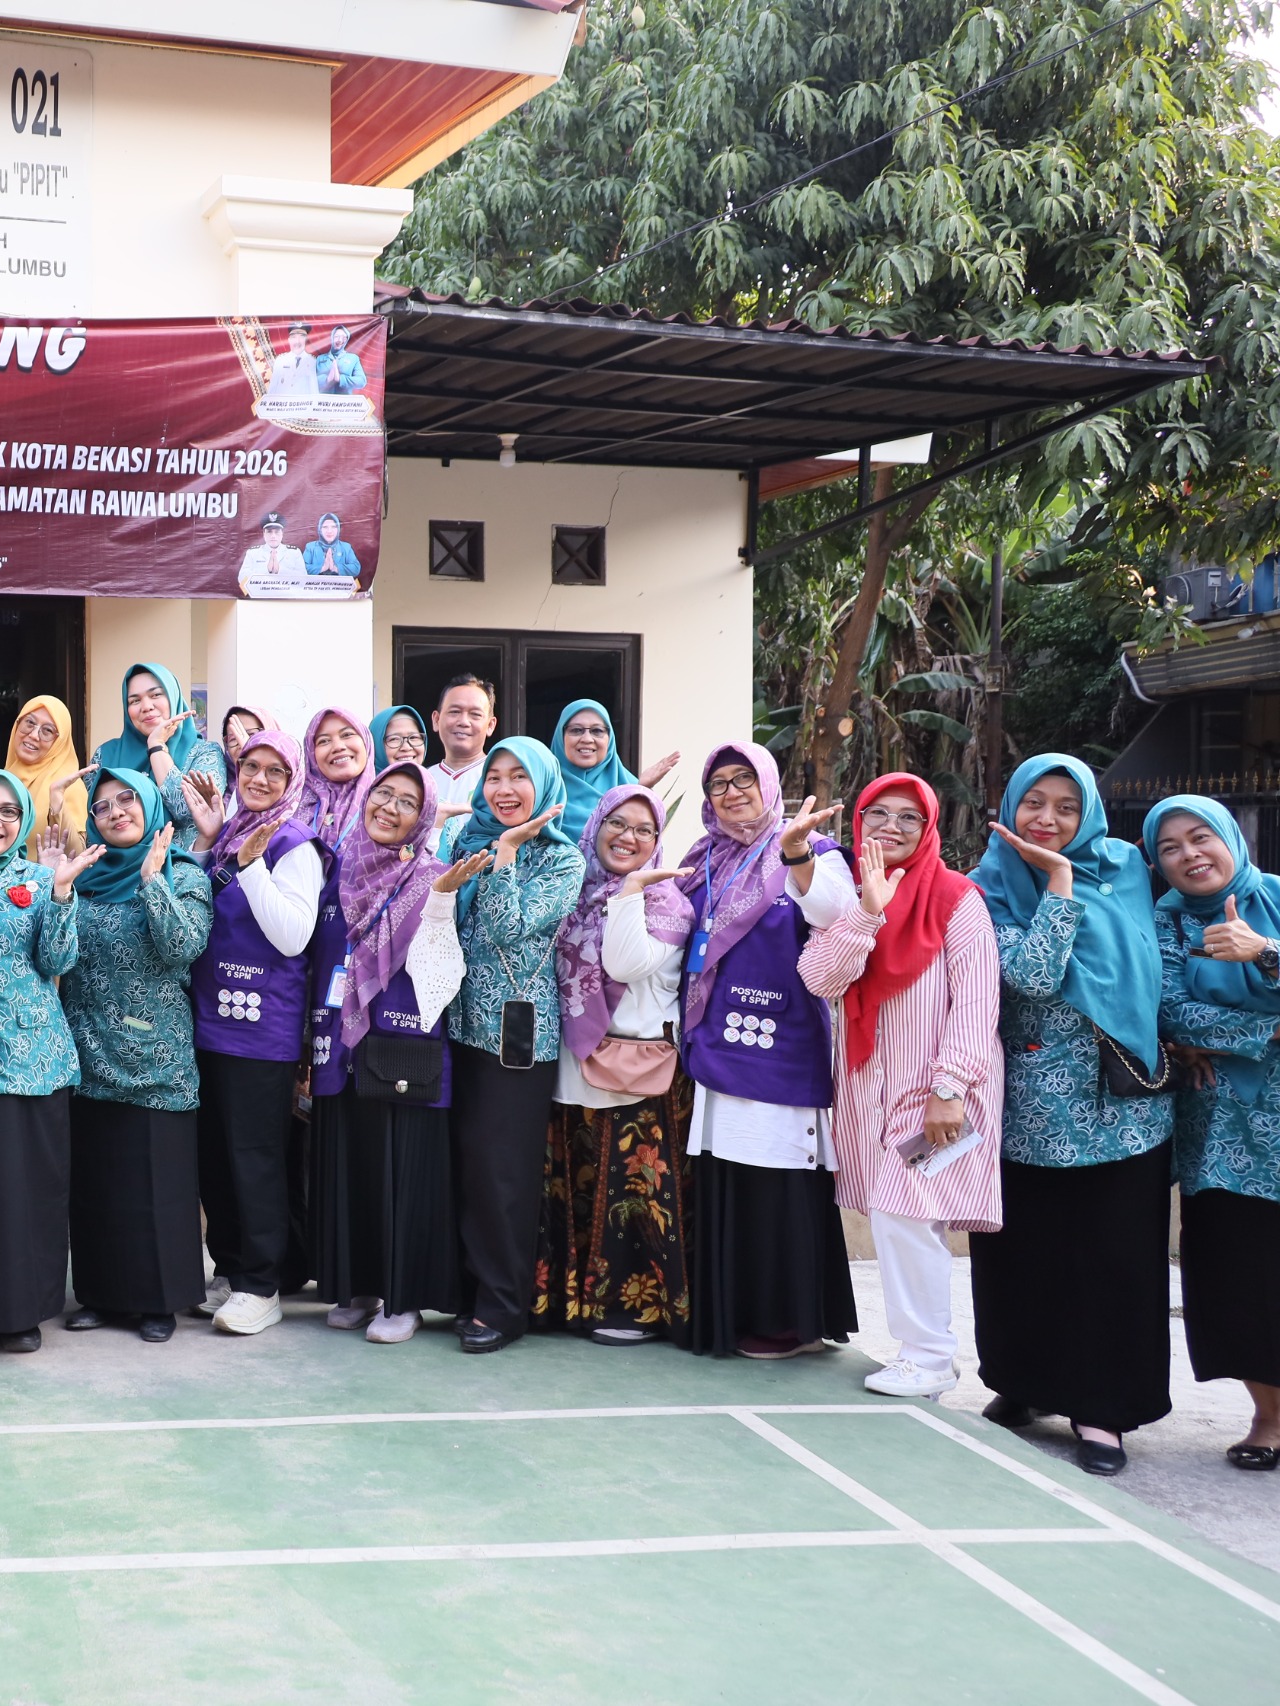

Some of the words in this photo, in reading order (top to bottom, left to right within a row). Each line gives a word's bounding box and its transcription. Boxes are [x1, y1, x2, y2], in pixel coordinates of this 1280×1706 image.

[11, 67, 61, 137] 021
[13, 161, 68, 198] "PIPIT"
[10, 441, 67, 470] KOTA
[72, 444, 152, 473] BEKASI
[156, 448, 231, 476] TAHUN
[234, 449, 288, 477] 2026
[91, 489, 238, 518] RAWALUMBU
[219, 962, 263, 974] POSYANDU
[233, 971, 251, 980] SPM
[731, 986, 782, 1000] POSYANDU
[741, 995, 747, 1003] 6
[749, 996, 769, 1005] SPM
[383, 1010, 422, 1022] POSYAND
[400, 1020, 417, 1029] SPM
